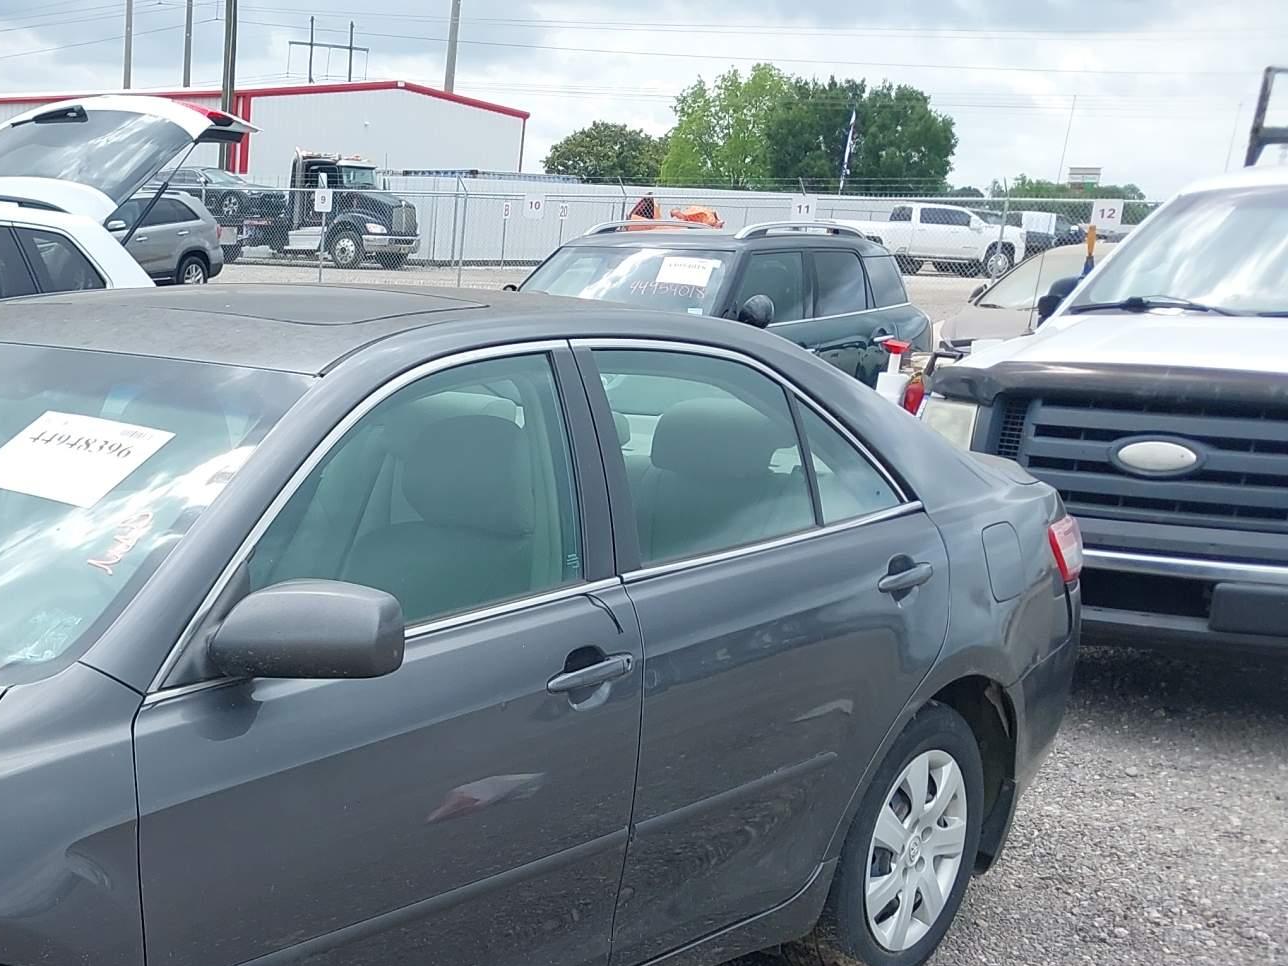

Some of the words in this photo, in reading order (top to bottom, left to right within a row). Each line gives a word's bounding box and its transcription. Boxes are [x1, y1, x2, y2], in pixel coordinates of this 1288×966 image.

[320, 195, 326, 204] 9
[529, 201, 541, 210] 10
[797, 204, 810, 214] 11
[1098, 208, 1116, 219] 12
[29, 430, 134, 459] 44948396
